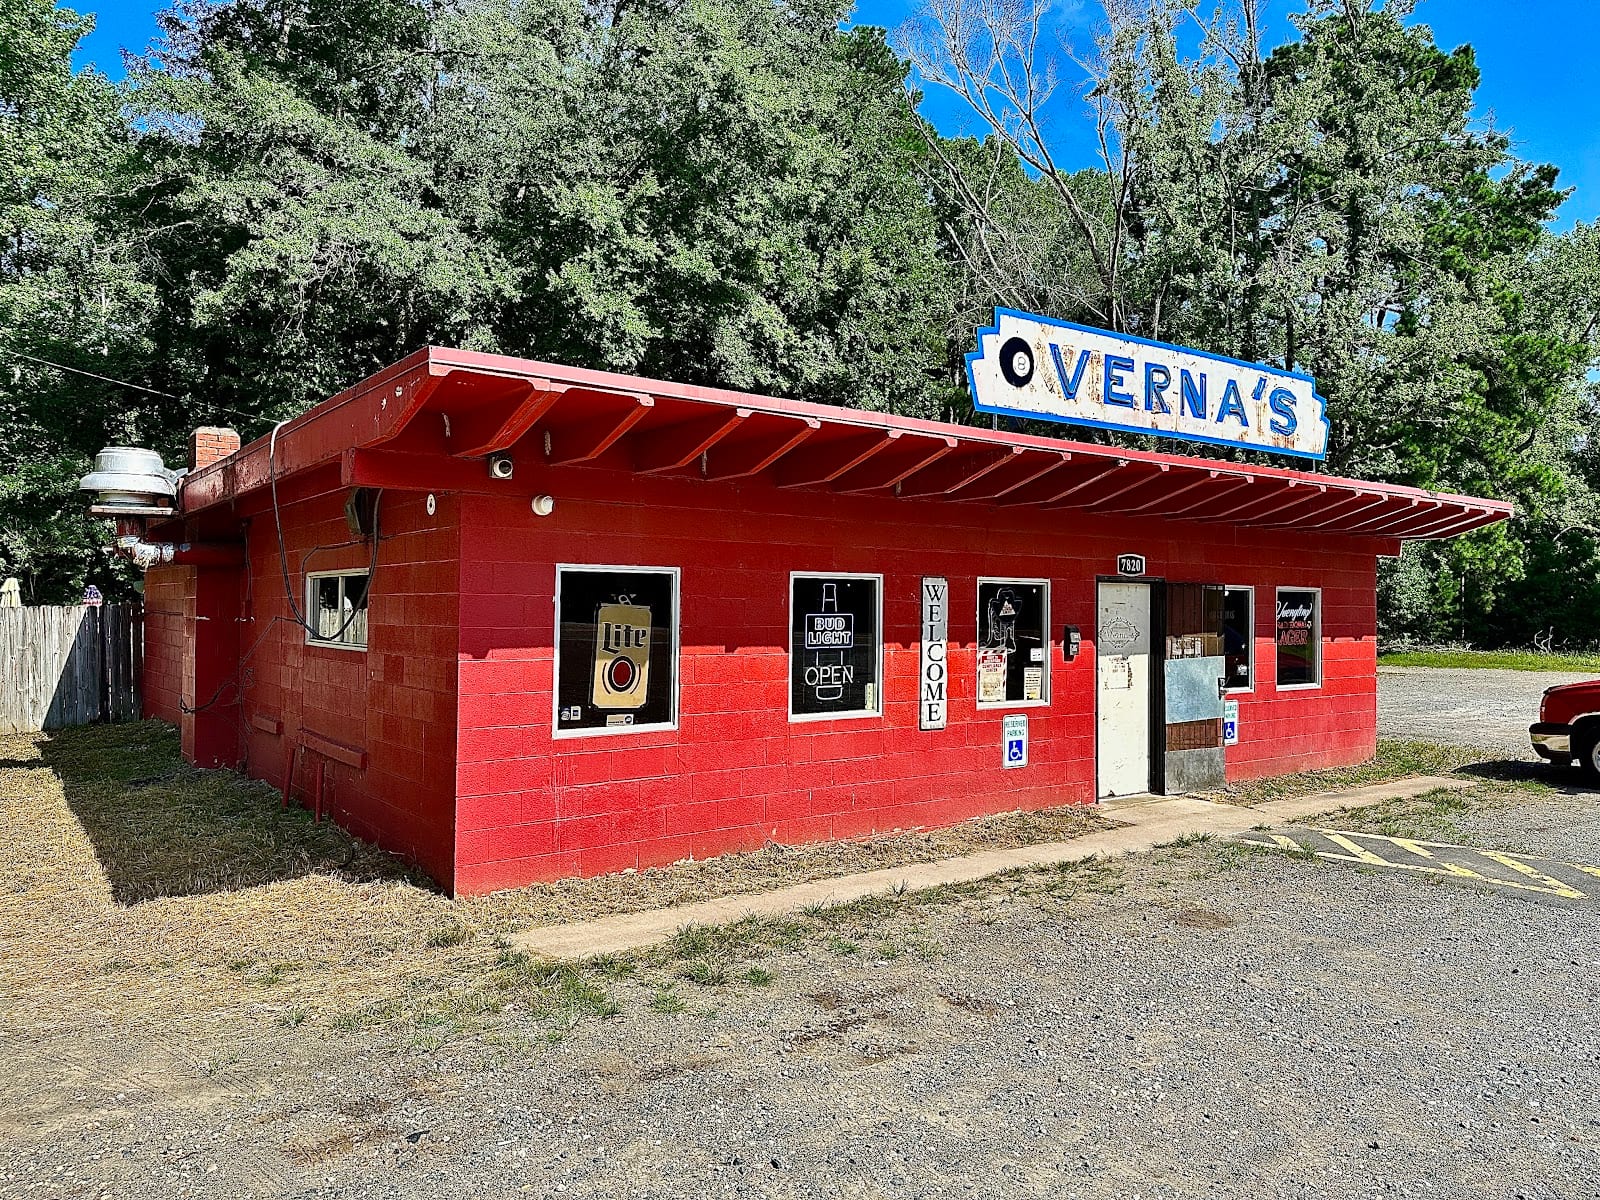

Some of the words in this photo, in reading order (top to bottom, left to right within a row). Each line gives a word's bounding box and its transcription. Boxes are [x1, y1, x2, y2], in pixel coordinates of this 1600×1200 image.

[1017, 356, 1026, 371] 8
[1049, 343, 1297, 437] VERNA'S
[1121, 558, 1141, 571] 7820
[1277, 600, 1313, 621] Yuengling
[814, 617, 846, 631] BUD
[600, 622, 647, 655] Lite
[808, 631, 851, 645] LIGHT
[1278, 630, 1308, 646] AGER
[924, 584, 946, 722] WELCOME
[805, 665, 854, 685] OPEN
[1007, 728, 1025, 737] PARKING
